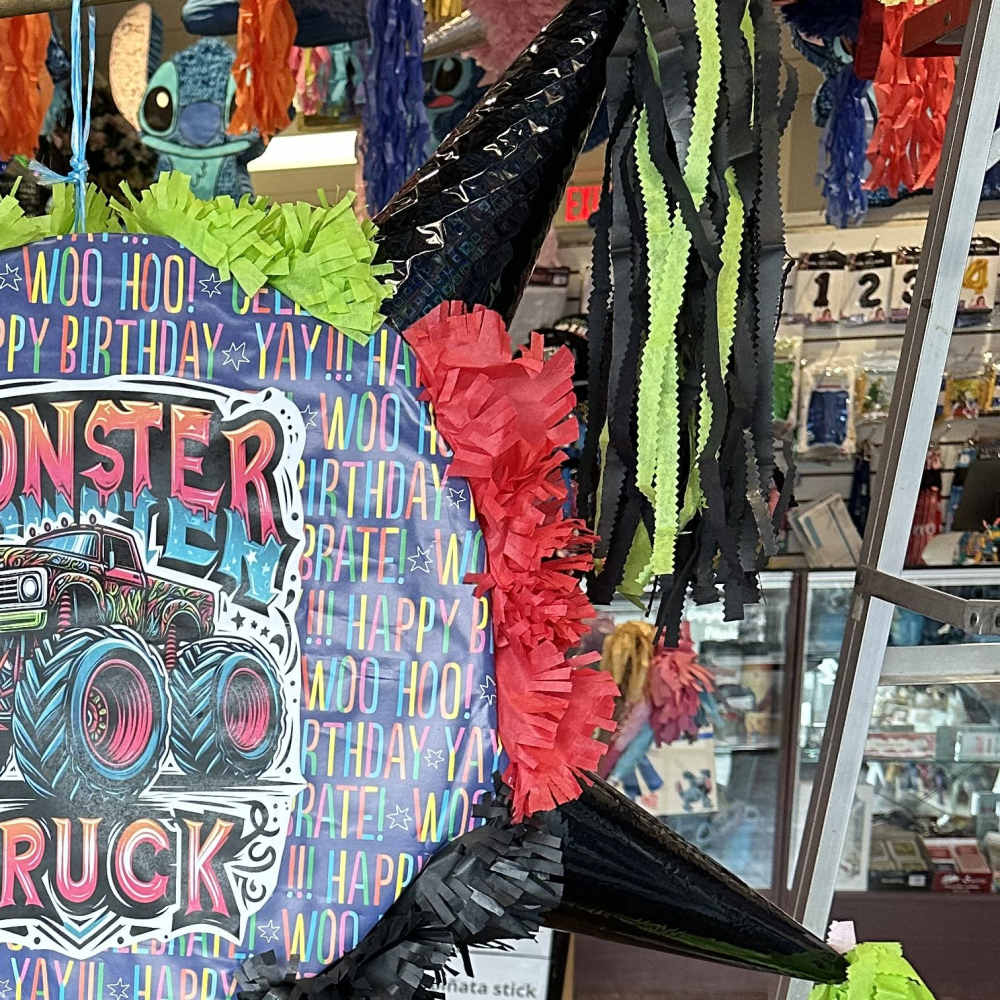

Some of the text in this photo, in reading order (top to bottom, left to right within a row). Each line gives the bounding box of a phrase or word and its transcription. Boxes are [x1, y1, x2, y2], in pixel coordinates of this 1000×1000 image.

[22, 247, 102, 307] WOO
[120, 252, 197, 314] HOO!
[813, 271, 831, 308] 1
[858, 271, 882, 309] 2
[962, 257, 989, 295] 4
[60, 314, 224, 380] BIRTHDAY
[255, 321, 354, 382] YAY!!!
[319, 391, 400, 452] WOO
[346, 596, 461, 654] HAPPY
[302, 655, 474, 721] WOO HOO!
[493, 980, 537, 999] stick
